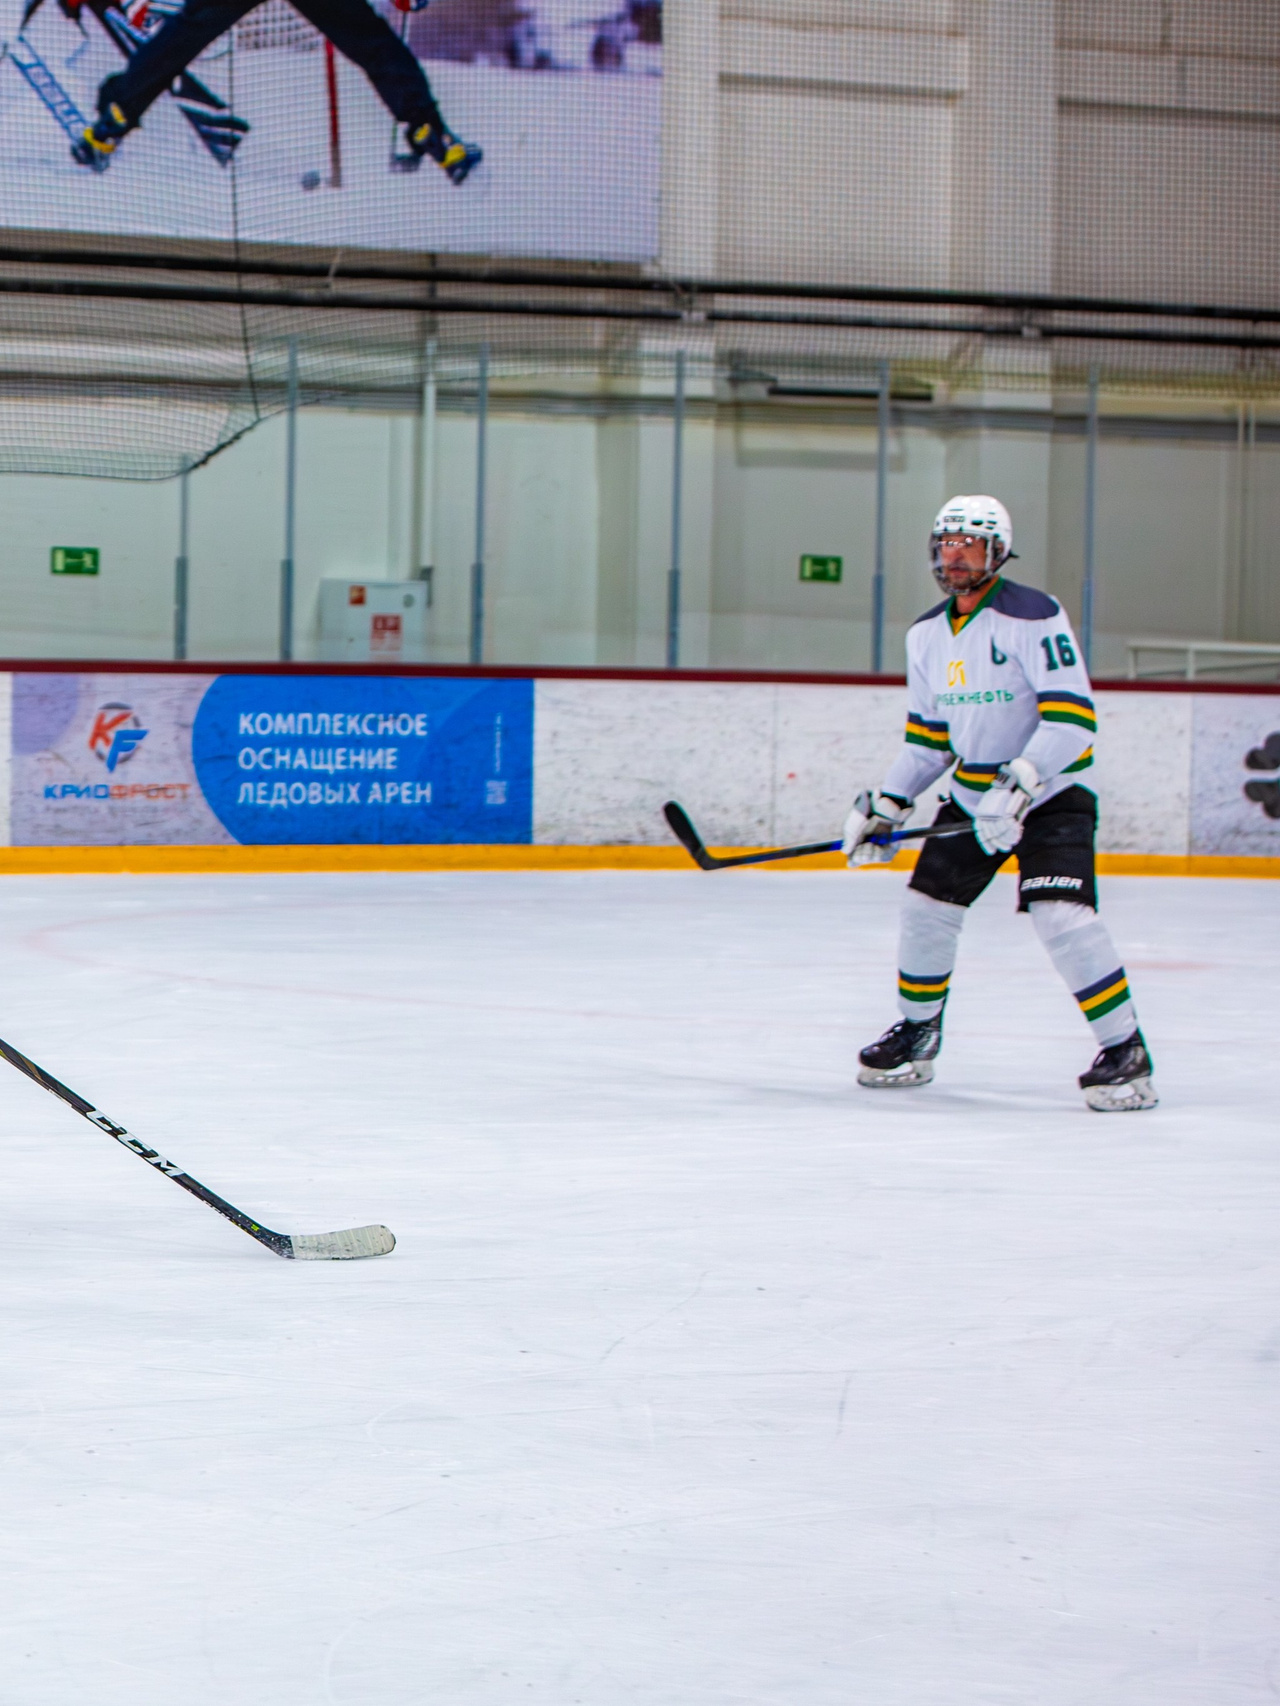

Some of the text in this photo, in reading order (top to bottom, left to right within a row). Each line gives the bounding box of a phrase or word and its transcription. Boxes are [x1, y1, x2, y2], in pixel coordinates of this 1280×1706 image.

[1041, 633, 1076, 672] 16
[238, 712, 429, 736] КОМПЛЕКСНОЕ
[238, 747, 399, 774] ОСНАЩЕНИЕ
[43, 783, 191, 800] КРИОФРОСТ
[238, 781, 433, 808] ЛЕДОВЫХ АРЕН
[1021, 875, 1083, 892] BAUER
[85, 1108, 186, 1178] CCM
